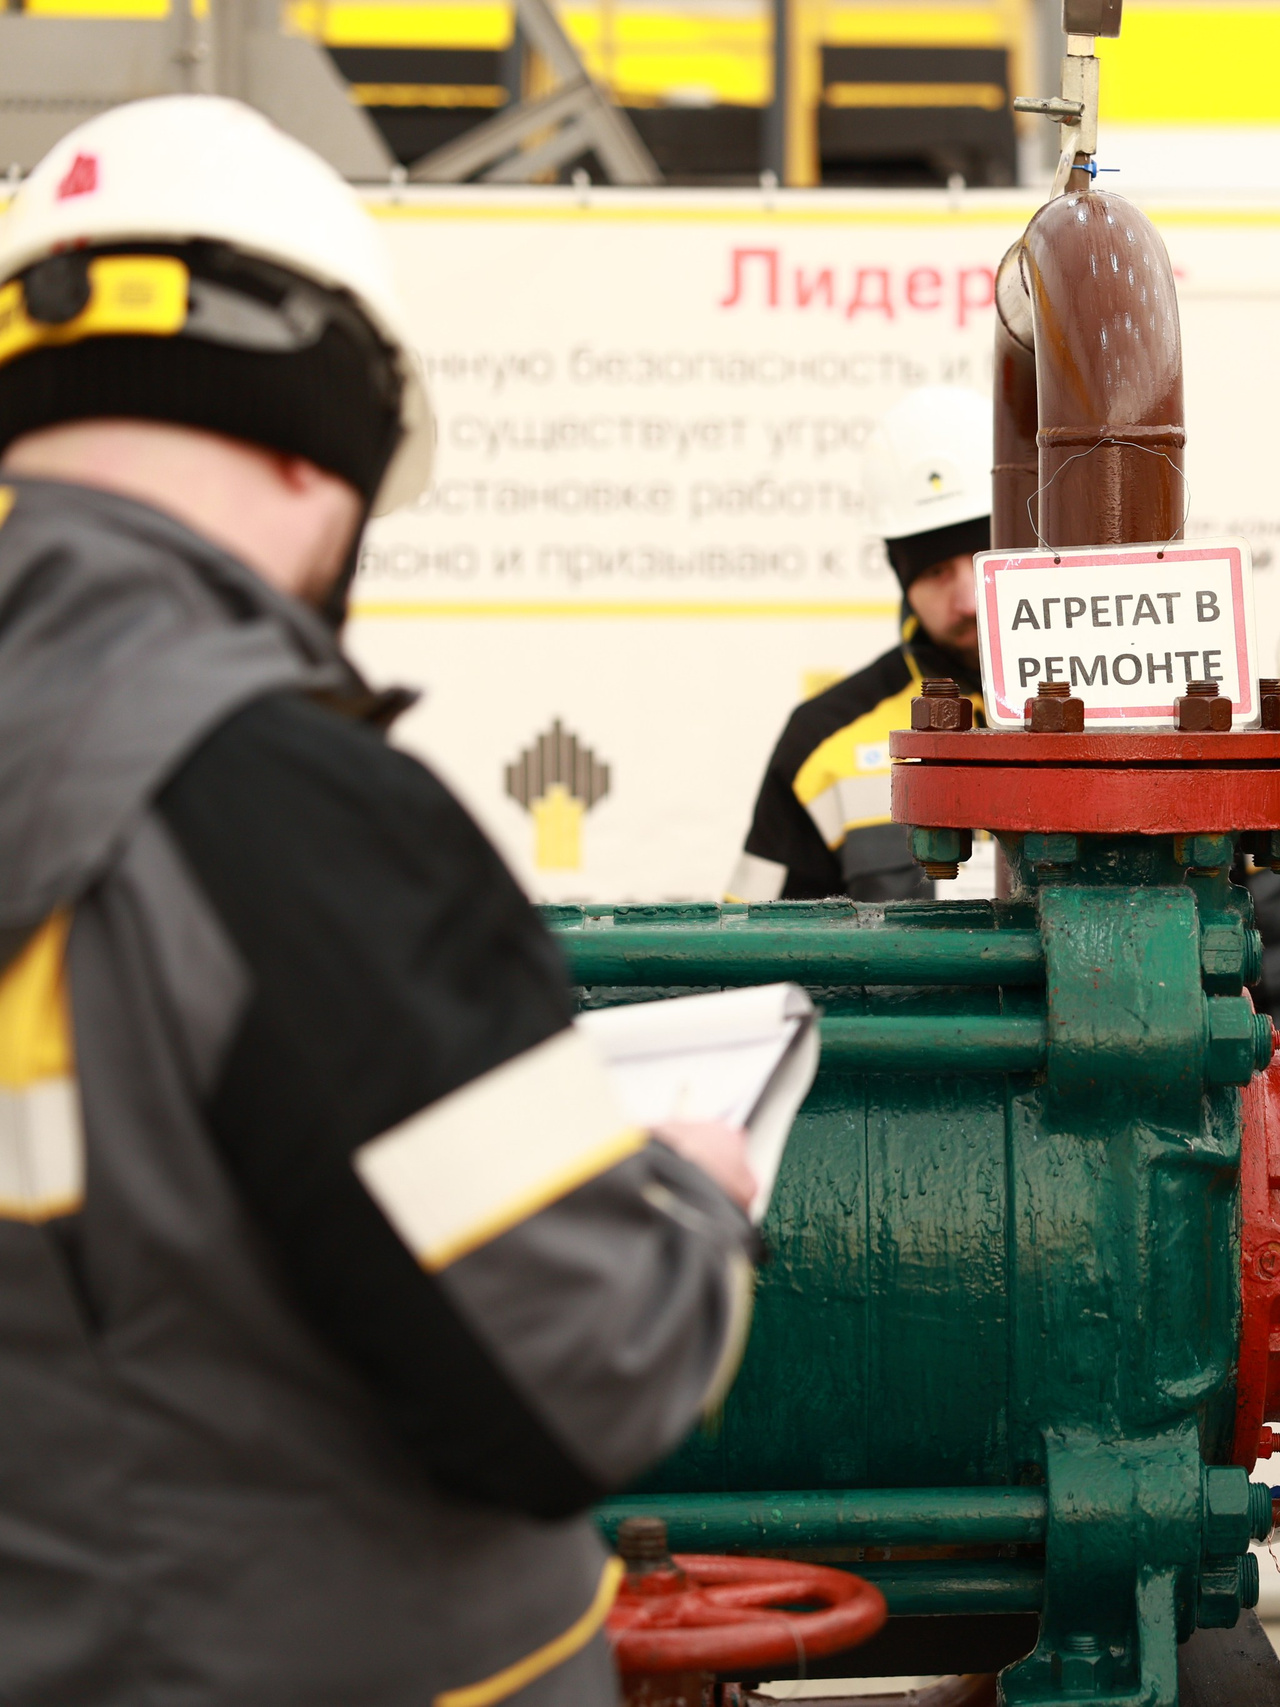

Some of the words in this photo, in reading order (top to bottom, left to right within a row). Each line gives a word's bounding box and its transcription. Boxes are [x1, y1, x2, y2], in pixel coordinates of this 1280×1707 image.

[568, 341, 927, 388] безопасность
[449, 414, 747, 458] существует
[538, 543, 807, 587] призываю
[1011, 591, 1181, 631] АГРЕГАТ
[1196, 589, 1222, 624] В
[1017, 649, 1225, 689] РЕМОНТЕ
